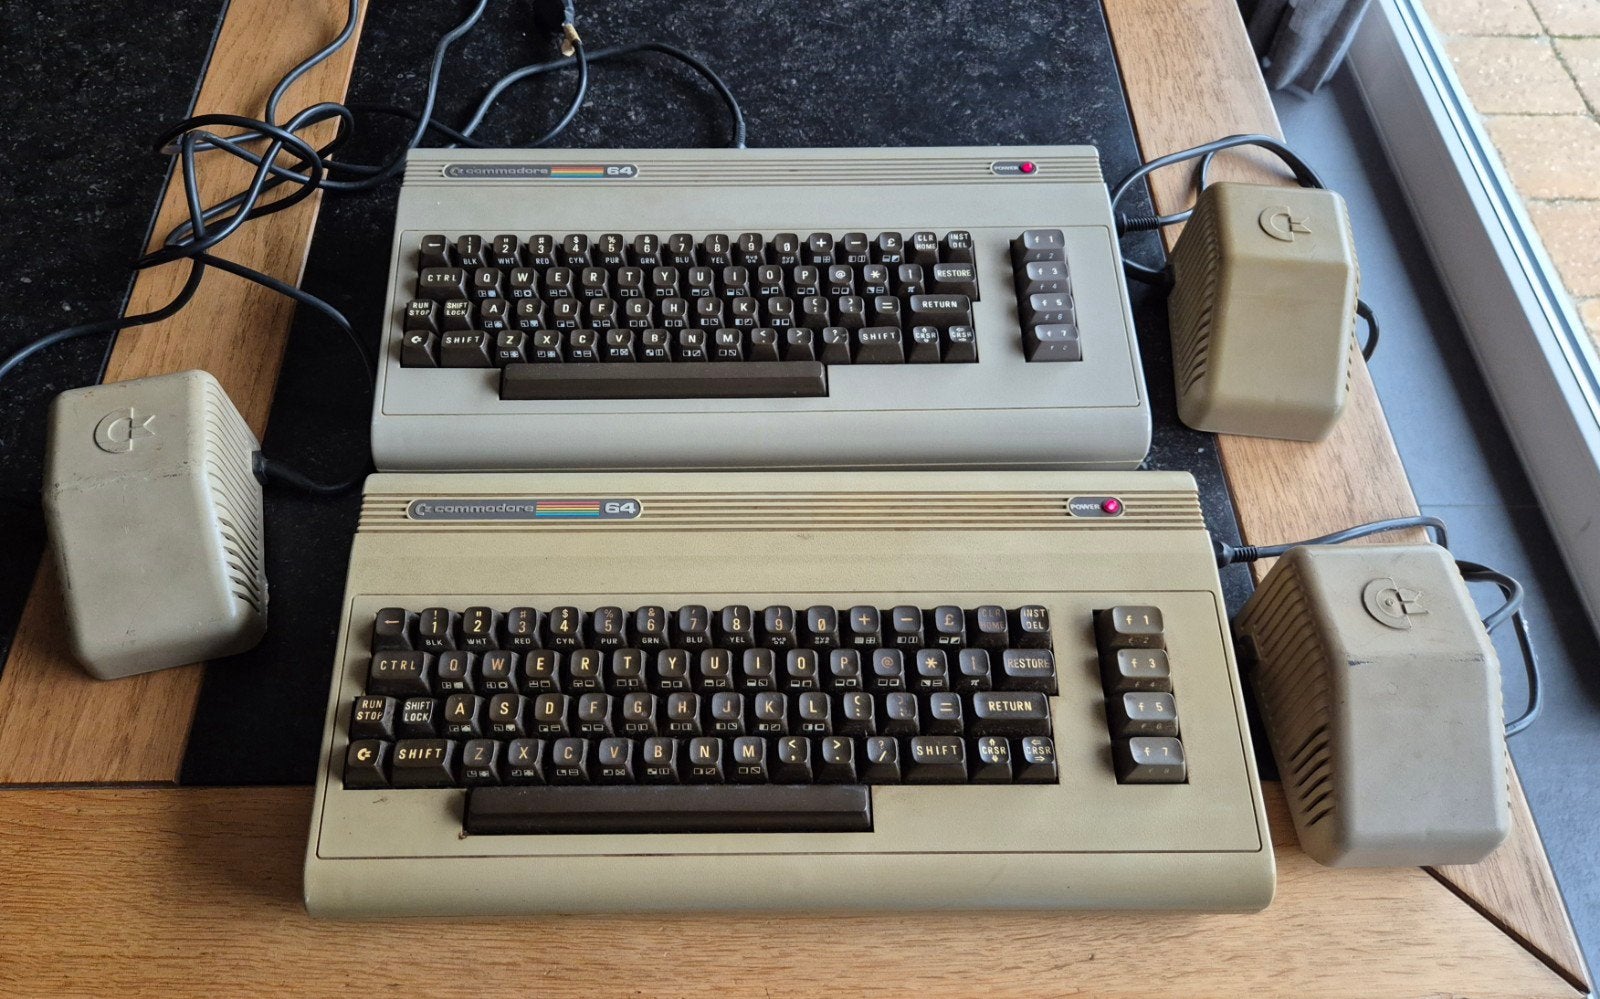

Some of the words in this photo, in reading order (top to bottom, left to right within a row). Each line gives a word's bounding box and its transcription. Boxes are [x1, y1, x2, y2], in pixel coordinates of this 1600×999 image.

[466, 167, 548, 175] commodore
[607, 166, 633, 175] 64
[467, 245, 471, 253] 1
[502, 245, 508, 253] 2
[538, 245, 544, 254] 3
[644, 245, 650, 253] 6
[679, 244, 685, 252] 7
[714, 244, 721, 252] 8
[748, 242, 754, 251] 9
[483, 273, 490, 282] Q
[517, 273, 528, 282] W
[555, 272, 561, 281] E
[590, 272, 597, 282] R
[626, 272, 634, 281] T
[661, 272, 669, 281] Y
[697, 272, 704, 281] U
[733, 271, 736, 281] I
[766, 271, 774, 280] O
[801, 271, 809, 280] P
[489, 304, 498, 313] A
[526, 304, 533, 313] S
[562, 304, 569, 313] D
[598, 304, 605, 313] F
[634, 304, 641, 313] G
[670, 304, 678, 312] H
[705, 303, 713, 312] J
[740, 302, 748, 311] K
[776, 303, 783, 311] L
[506, 336, 514, 344] Z
[543, 336, 550, 344] X
[579, 335, 586, 343] C
[652, 334, 658, 342] B
[688, 335, 696, 343] N
[722, 334, 733, 342] M
[862, 332, 896, 340] SHIFT
[434, 503, 534, 513] commodore
[604, 502, 636, 514] 64
[1024, 609, 1045, 617] INST
[432, 622, 437, 634] 1
[474, 620, 481, 632] 2
[518, 621, 526, 633] 3
[560, 619, 569, 632] 4
[604, 620, 612, 632] 5
[647, 619, 655, 631] 6
[690, 618, 698, 630] 7
[732, 619, 741, 631] 8
[775, 618, 783, 630] 9
[1026, 622, 1044, 630] DEL
[380, 660, 416, 671] CTRL
[450, 659, 458, 671] Q
[491, 658, 505, 671] W
[536, 657, 545, 670] E
[581, 657, 590, 670] R
[624, 656, 632, 669] T
[668, 657, 677, 670] Y
[710, 657, 719, 670] U
[756, 657, 760, 669] I
[797, 657, 806, 670] O
[841, 657, 848, 669] P
[1007, 658, 1050, 668] RESTORE
[362, 700, 382, 708] RUN
[405, 702, 432, 710] SHIFT
[454, 702, 465, 715] A
[500, 702, 509, 715] S
[545, 701, 554, 714] D
[590, 701, 598, 714] F
[634, 701, 642, 713] G
[678, 701, 687, 713] H
[723, 701, 731, 713] J
[765, 700, 775, 713] K
[809, 700, 817, 713] L
[988, 701, 1032, 712] RETURN
[356, 712, 383, 720] STOP
[404, 713, 429, 722] LOCK
[399, 748, 442, 759] SHIFT
[474, 747, 484, 760] Z
[518, 747, 529, 760] X
[564, 746, 573, 759] C
[610, 746, 619, 759] V
[654, 746, 662, 758] B
[700, 746, 710, 758] N
[742, 745, 755, 758] M
[916, 745, 958, 756] SHIFT
